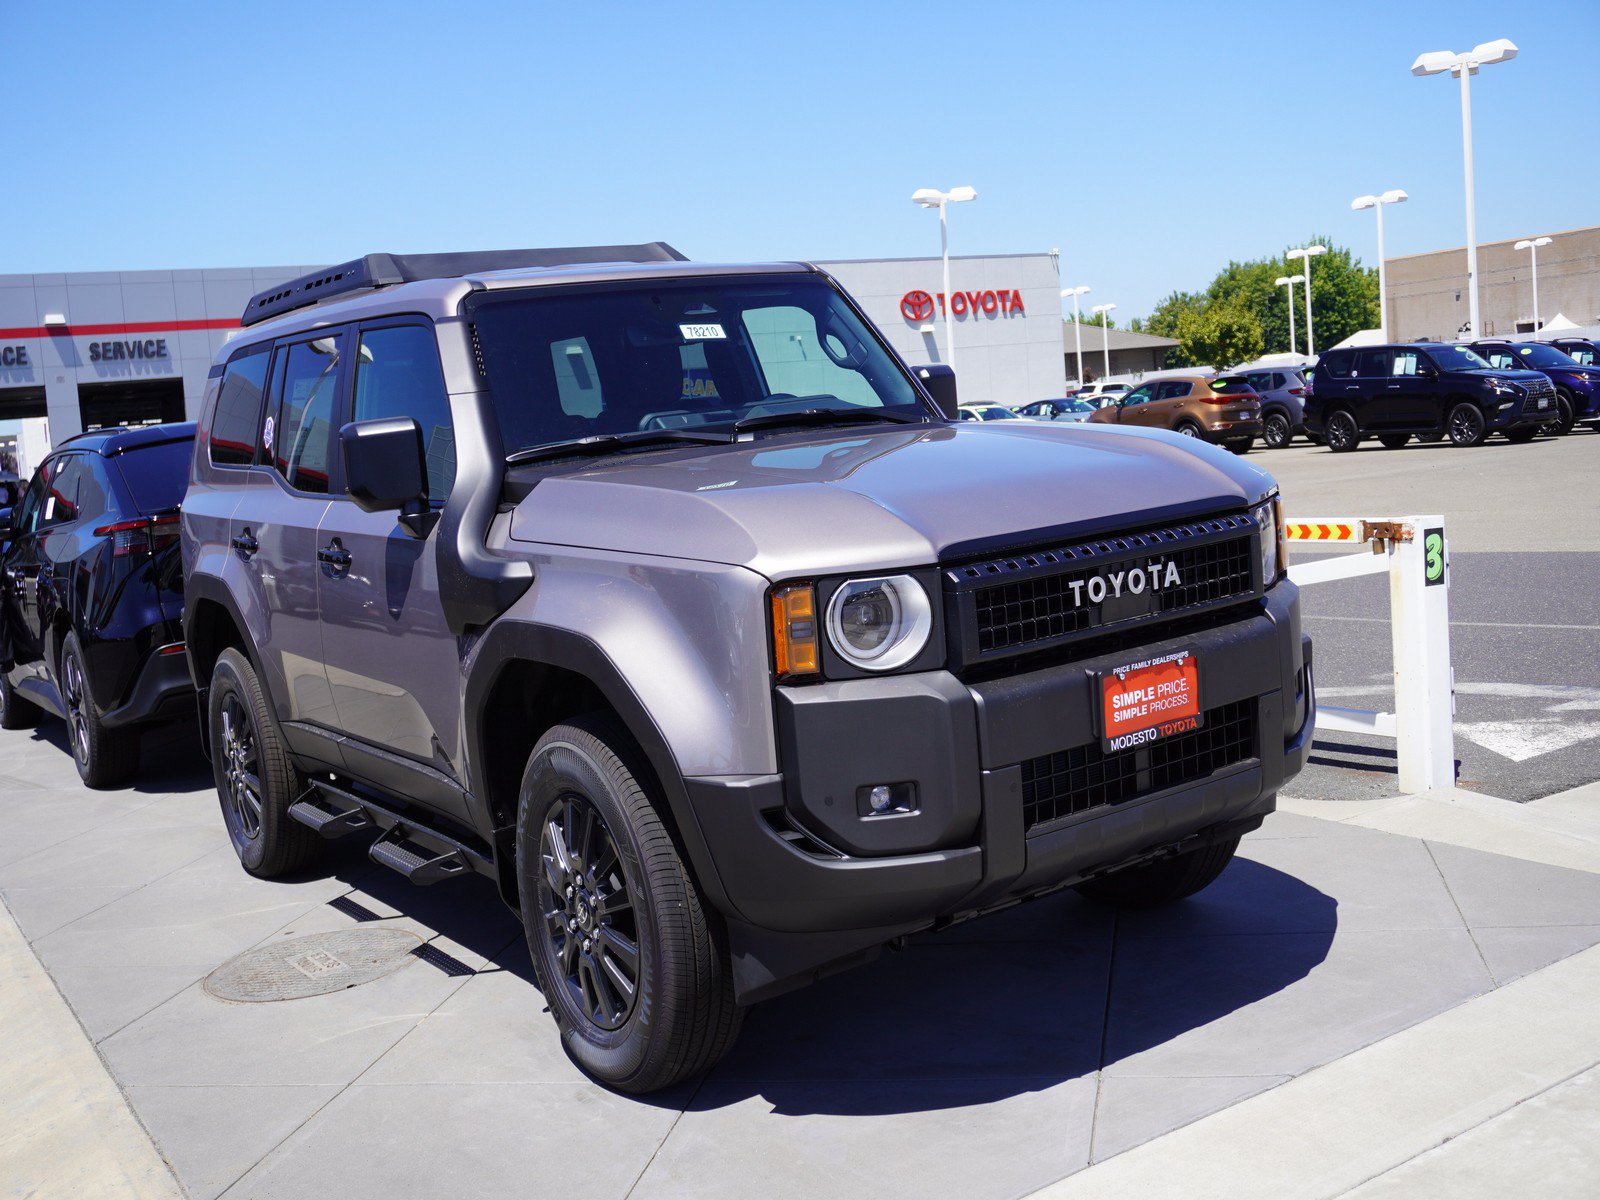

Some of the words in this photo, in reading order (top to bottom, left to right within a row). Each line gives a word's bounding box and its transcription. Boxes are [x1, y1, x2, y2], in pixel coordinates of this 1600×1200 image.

[936, 289, 1025, 317] TOYOTA
[687, 326, 719, 338] 78210
[89, 339, 168, 362] SERVICE
[1425, 533, 1443, 581] 3
[1068, 561, 1181, 607] TOYOTA
[1113, 664, 1130, 675] PRICE
[1131, 660, 1151, 672] FAMILY
[1152, 651, 1189, 666] DEALERSHIPS
[1112, 687, 1155, 709] SIMPLE
[1157, 678, 1189, 697] PRICE.
[1113, 704, 1148, 722] SIMPLE
[1150, 694, 1189, 713] PROCESS.
[1110, 728, 1157, 751] MODESTO
[1159, 717, 1197, 737] TOYOTA
